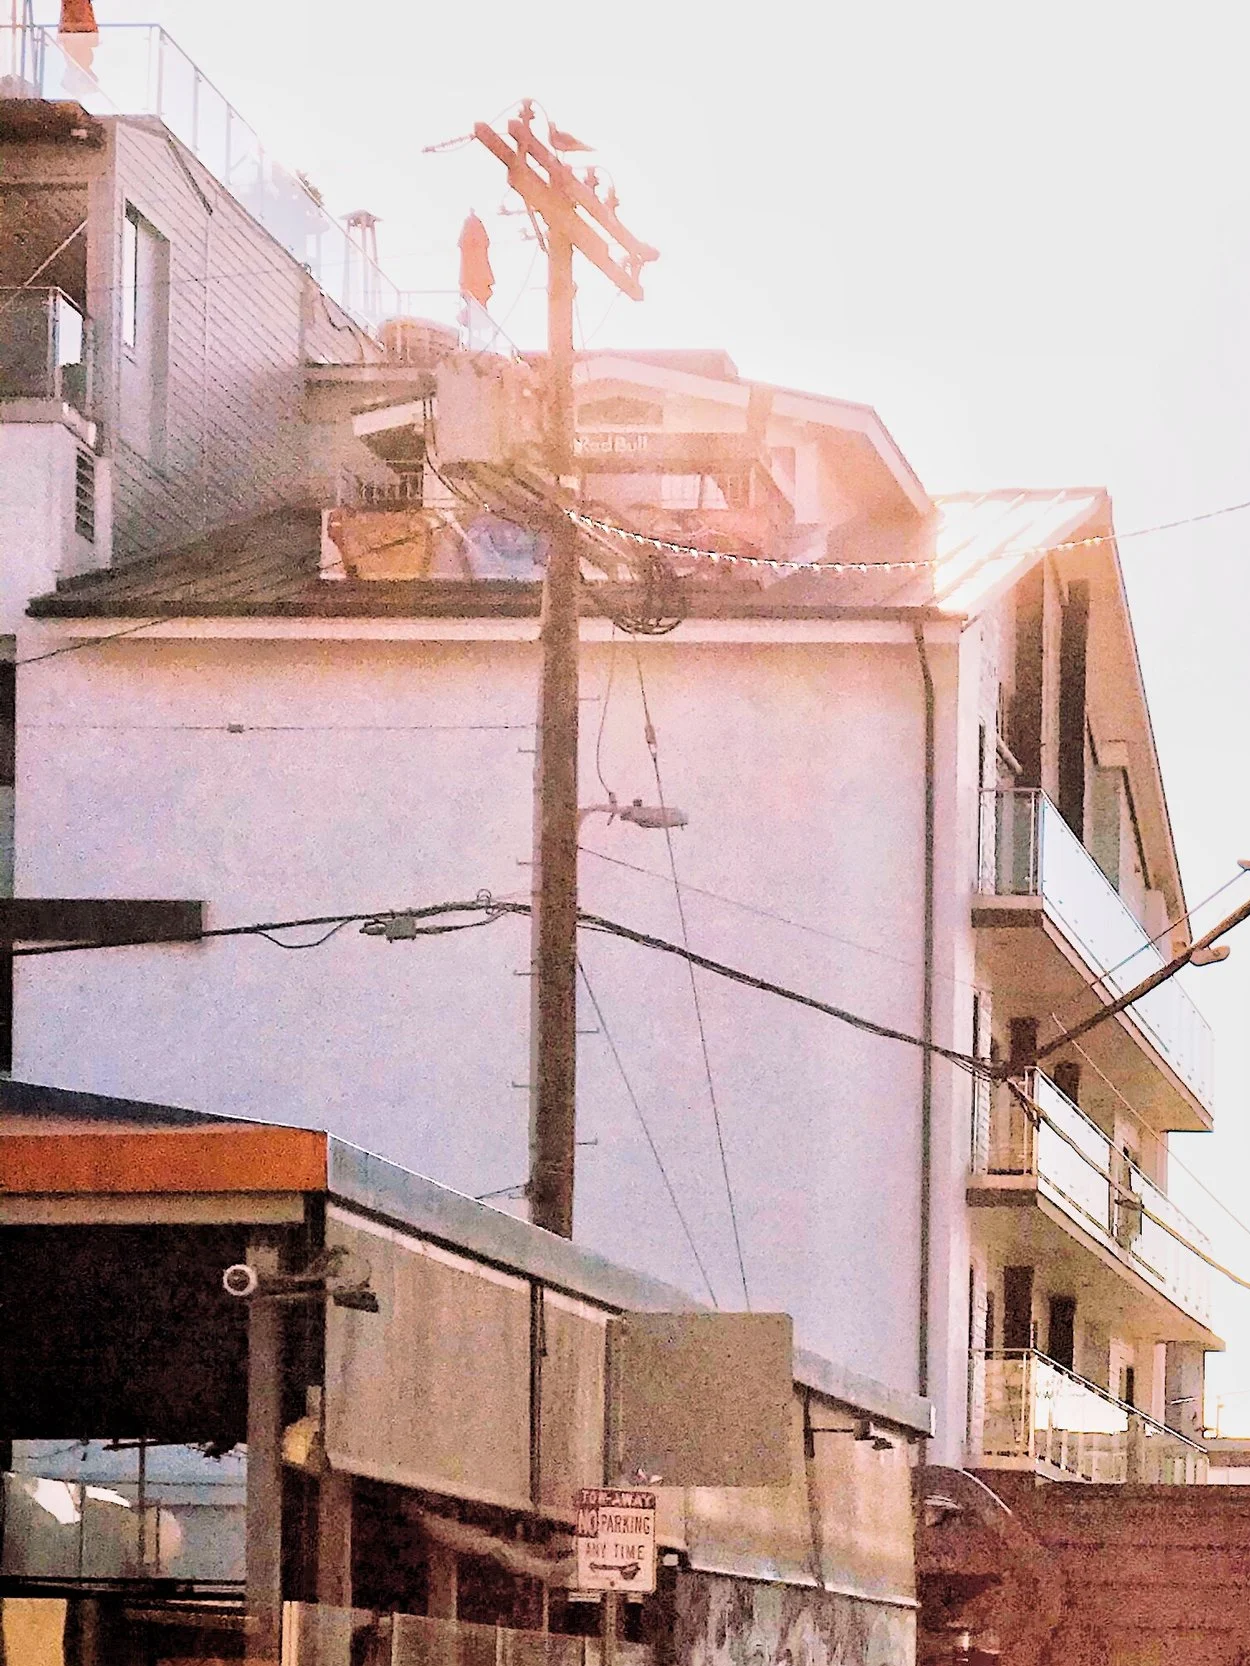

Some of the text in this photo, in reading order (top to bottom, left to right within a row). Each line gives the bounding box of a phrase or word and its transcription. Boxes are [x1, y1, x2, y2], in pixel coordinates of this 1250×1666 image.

[578, 1509, 650, 1535] NO PARKING
[585, 1543, 645, 1560] ANY TIME
